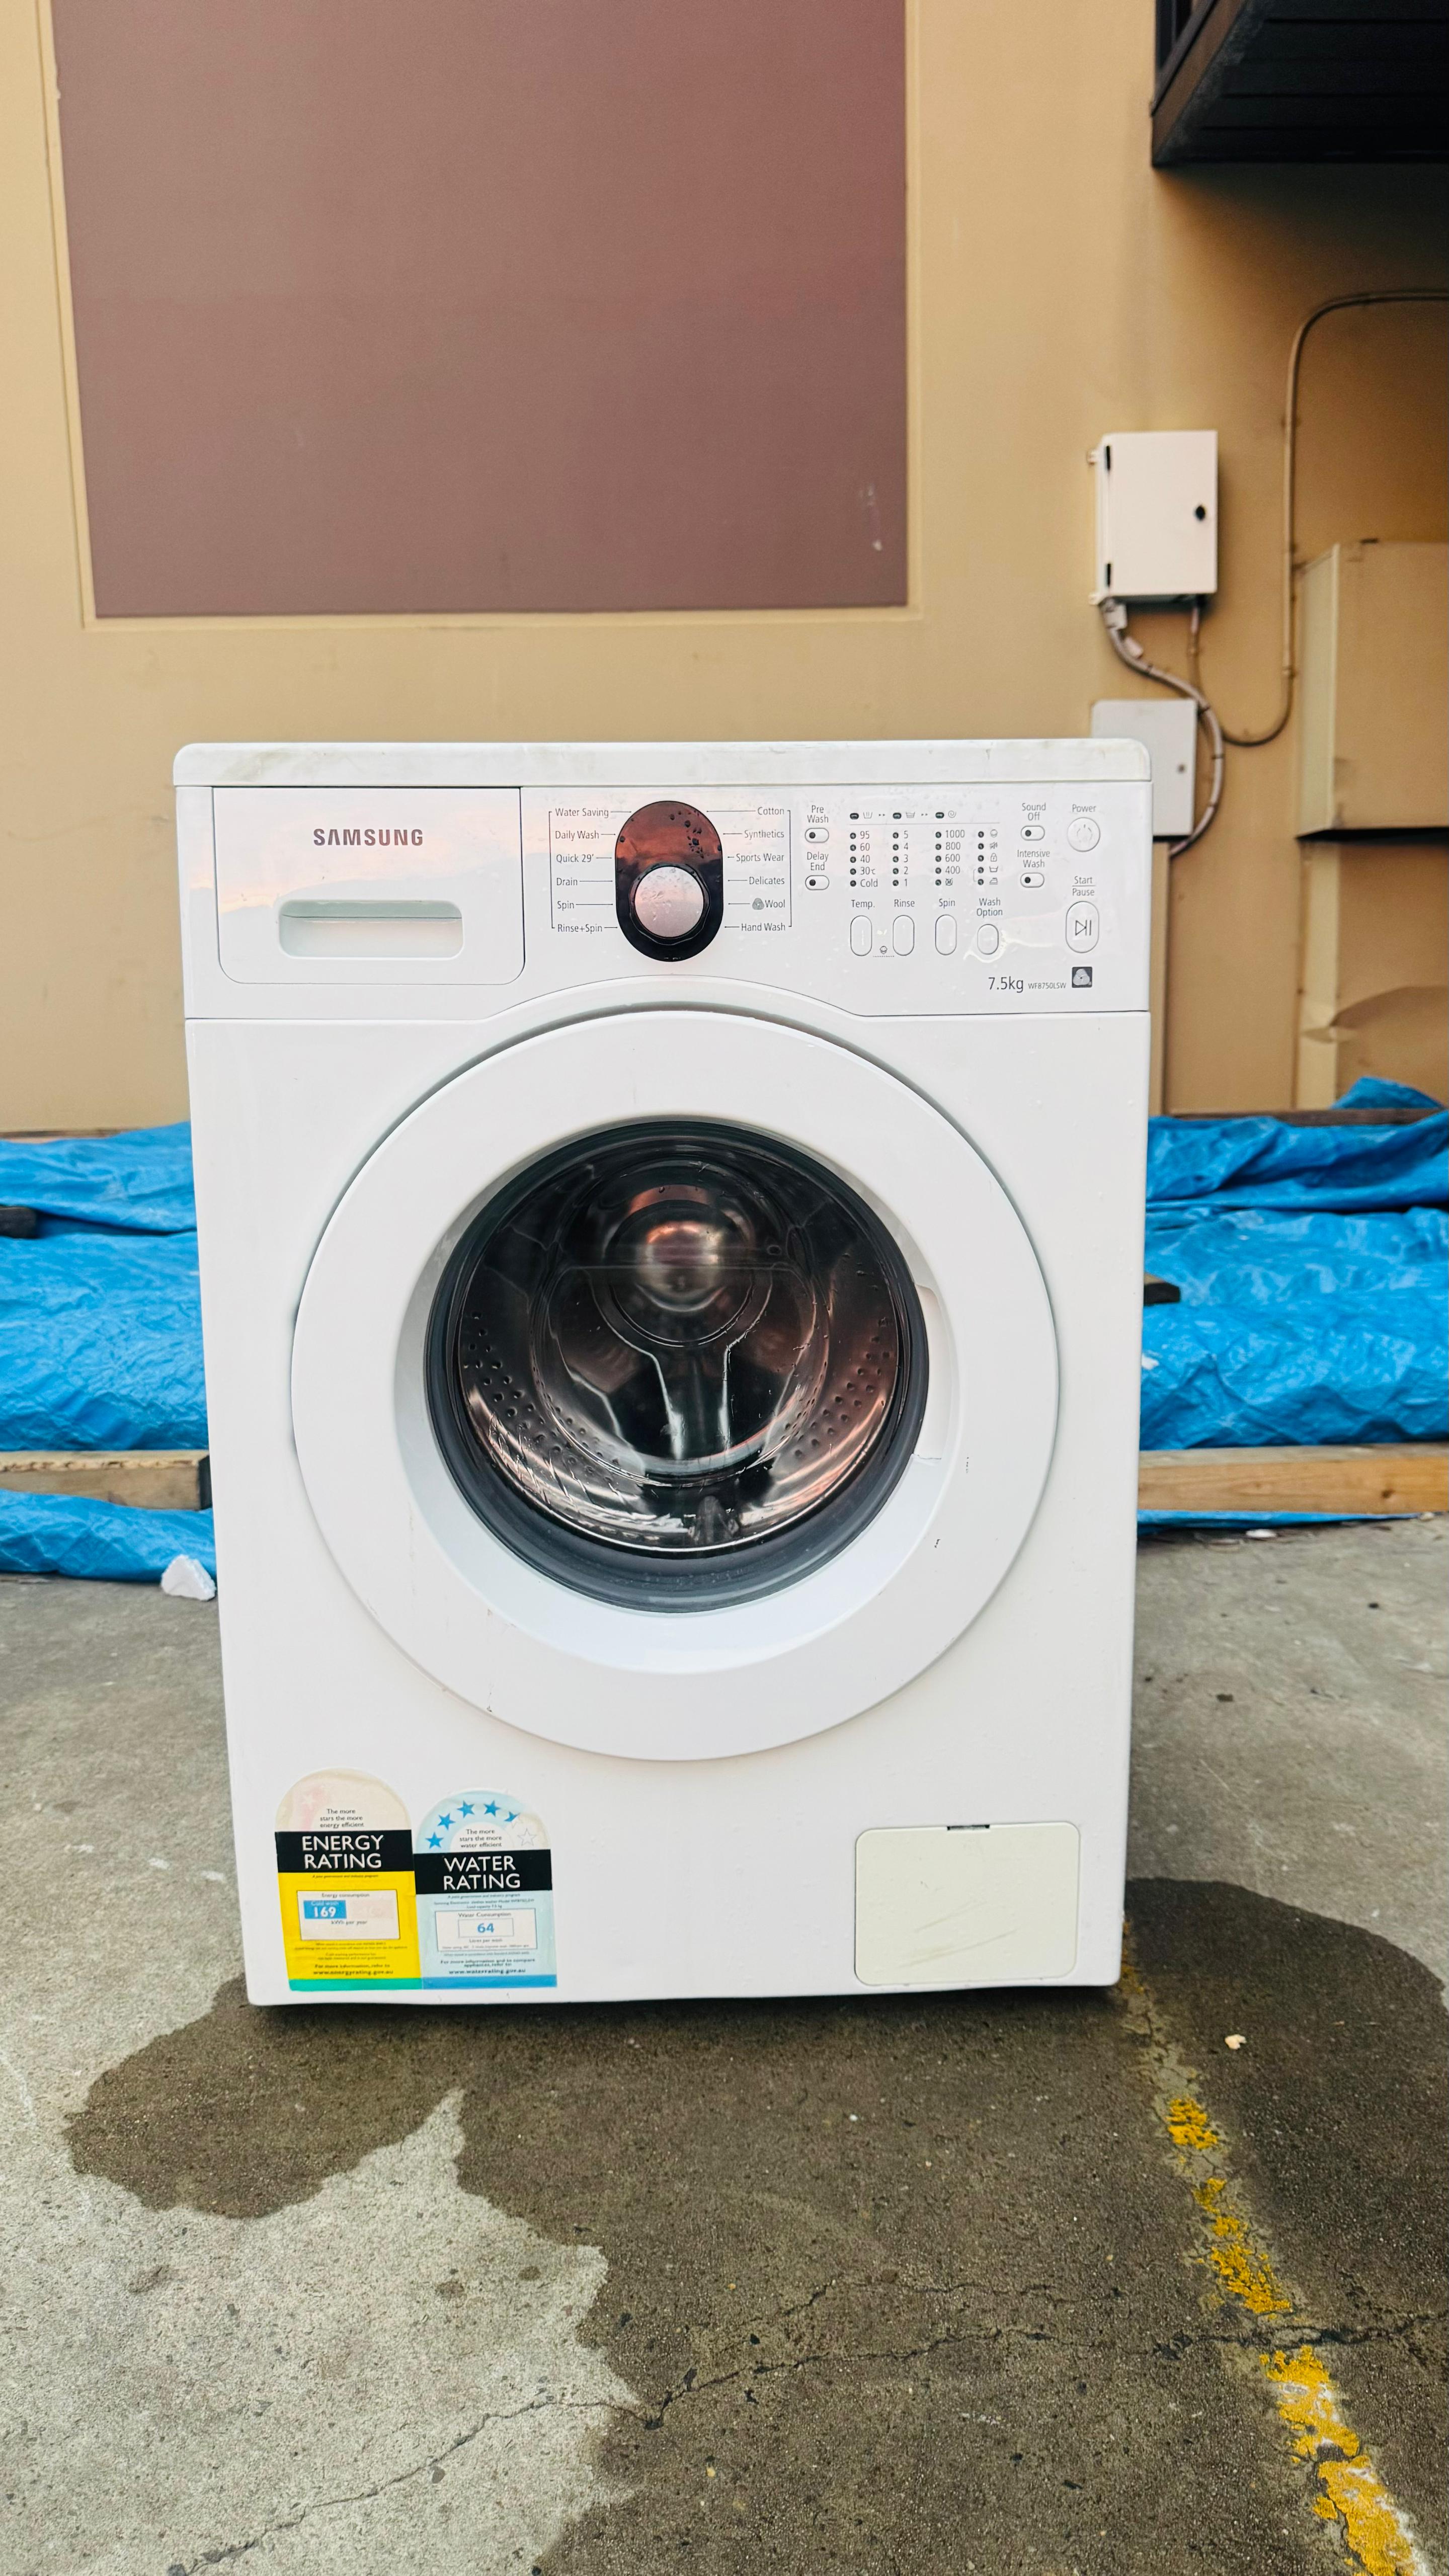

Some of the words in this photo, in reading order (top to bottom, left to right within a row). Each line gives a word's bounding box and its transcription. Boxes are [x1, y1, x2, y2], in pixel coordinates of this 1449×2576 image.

[757, 807, 784, 816] Cotton
[812, 806, 824, 814] Pre
[1022, 803, 1046, 811] Sound
[555, 808, 580, 817] Water
[582, 808, 609, 819] Saving
[1028, 812, 1040, 821] Off
[807, 815, 829, 823] Wash
[313, 829, 423, 846] SAMSUNG
[555, 830, 575, 840] Daily
[577, 830, 599, 839] Wash
[744, 829, 784, 839] Synthetics
[860, 831, 870, 839] 95
[904, 831, 909, 839] 5
[945, 830, 965, 838] 1000
[860, 843, 870, 851] 60
[903, 842, 909, 851] 4
[945, 842, 960, 850] 800
[556, 854, 579, 862] Quick
[736, 853, 761, 862] Sports
[764, 853, 784, 861] Wear
[807, 852, 829, 861] Delay
[904, 854, 909, 863] 3
[945, 854, 960, 862] 600
[1017, 850, 1050, 858] Intensive
[860, 855, 870, 863] 40
[1023, 859, 1045, 868] Wash
[811, 863, 825, 871] End
[904, 866, 909, 875] 2
[945, 866, 960, 874] 400
[557, 877, 578, 886] Drain
[749, 876, 785, 885] Delicates
[860, 879, 878, 888] Cold
[1074, 876, 1093, 884] Start
[1072, 888, 1095, 896] Pause
[557, 901, 575, 910] Spin
[765, 900, 785, 908] Wool
[851, 899, 875, 910] Temp.
[894, 899, 915, 908] Rinse
[939, 899, 955, 909] Spin
[979, 898, 1001, 907] Wash
[977, 908, 1003, 918] Option
[558, 923, 603, 933] Rinse+Spin
[742, 923, 761, 931] Hand
[763, 923, 785, 931] Wash
[988, 976, 1023, 993] 7.5kg
[302, 1834, 384, 1851] ENERGY
[304, 1853, 381, 1869] RATING
[444, 1856, 516, 1872] WATER
[443, 1873, 521, 1890] RATING
[314, 1907, 337, 1917] 169
[477, 1923, 494, 1933] 64
